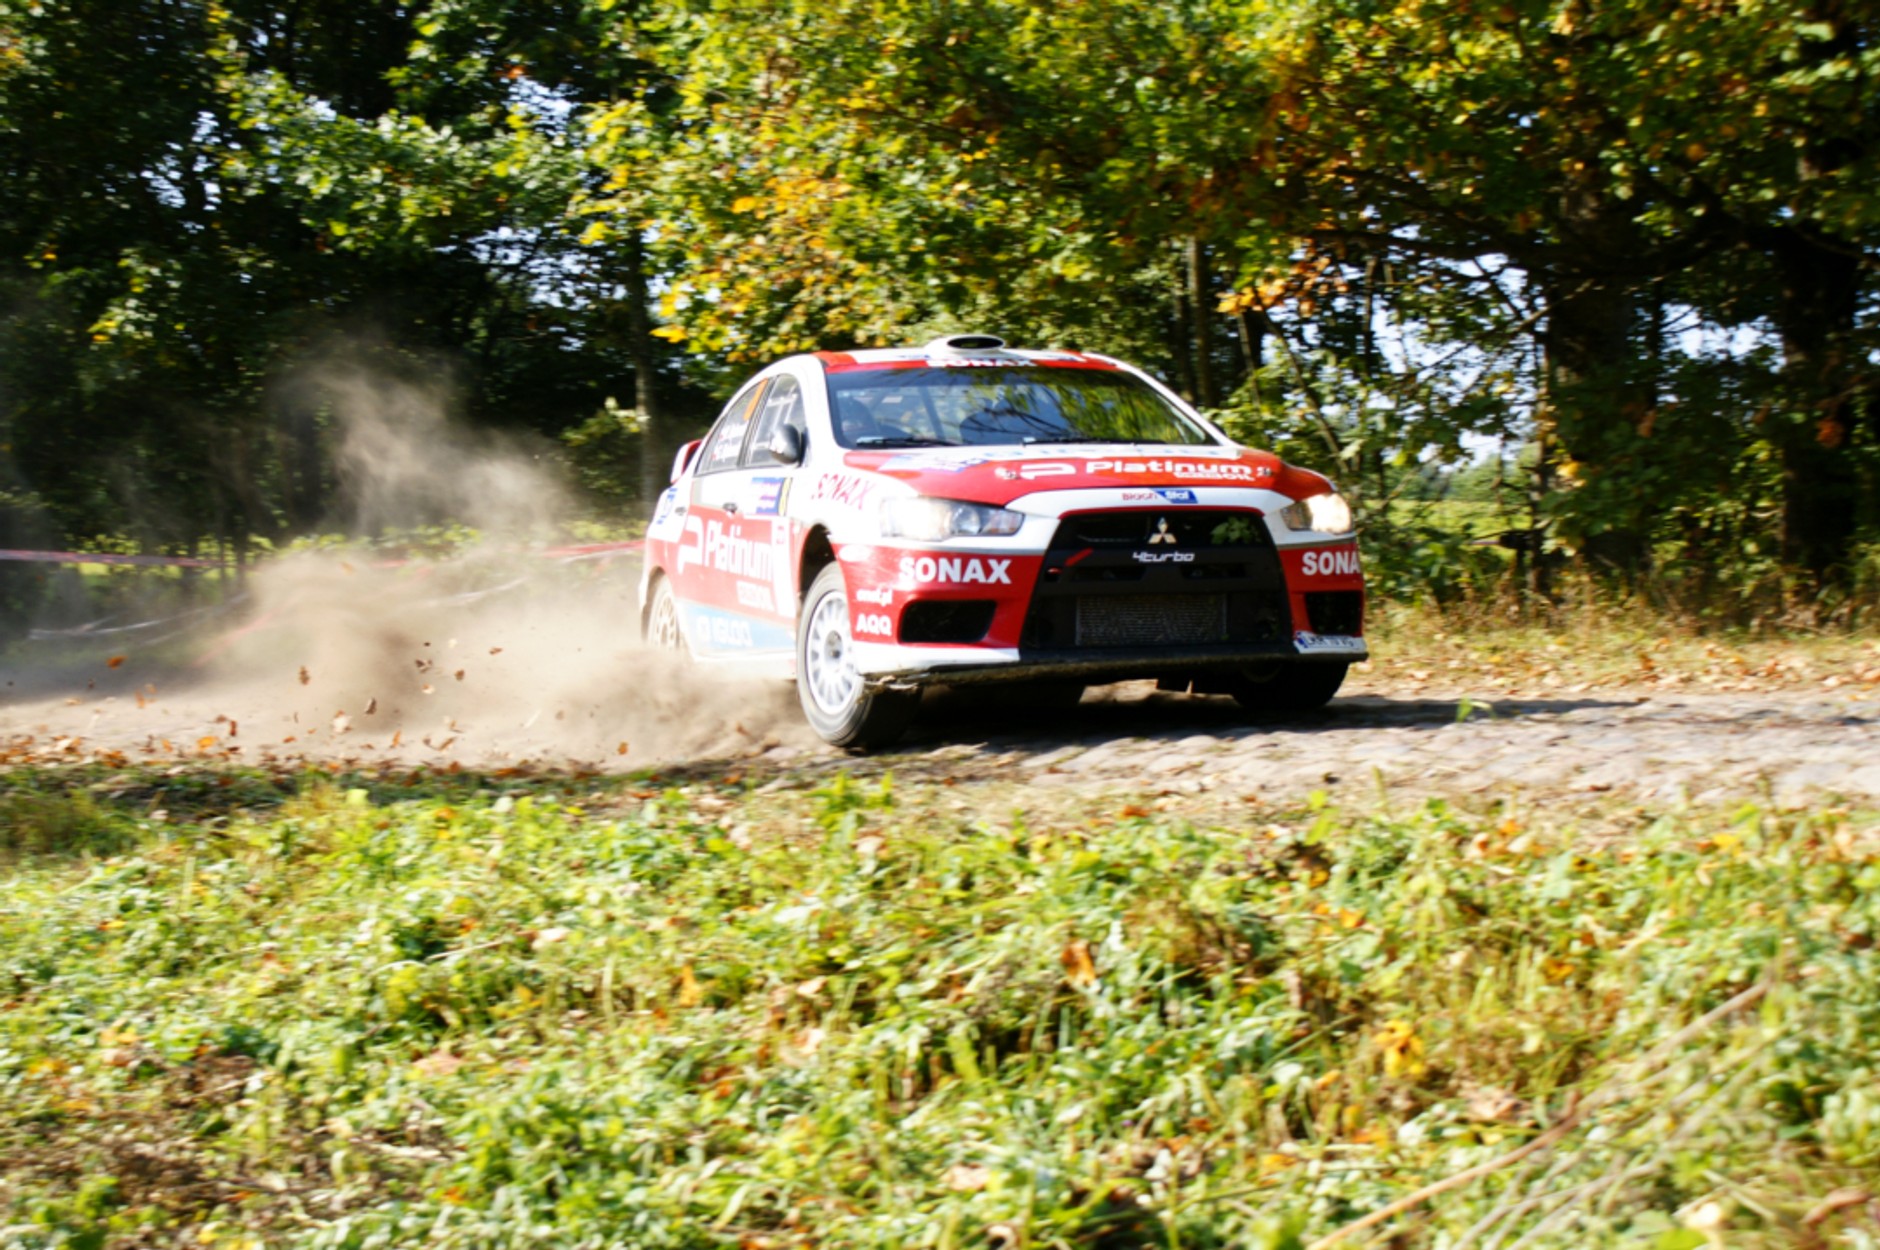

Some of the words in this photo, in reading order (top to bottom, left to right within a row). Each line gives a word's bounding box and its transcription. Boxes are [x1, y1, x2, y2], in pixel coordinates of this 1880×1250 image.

[1086, 460, 1251, 477] Platinum
[812, 473, 876, 510] SONAX
[704, 519, 773, 583] Platinum
[1132, 551, 1195, 562] 4turbo
[900, 557, 1012, 585] SONAX
[855, 613, 892, 636] AQQ
